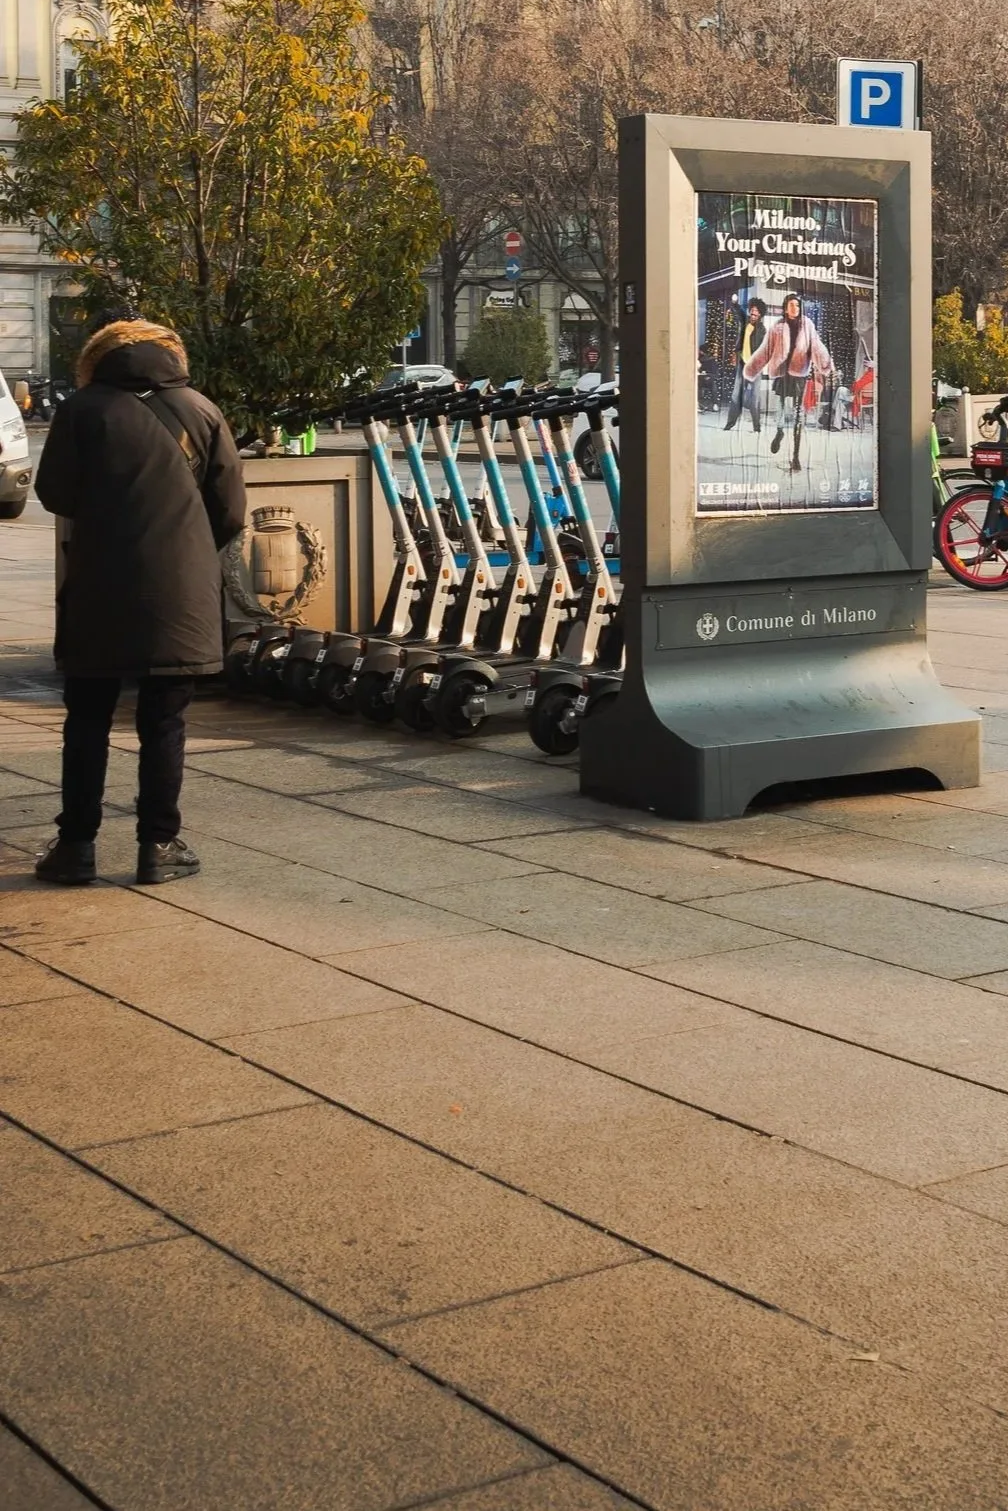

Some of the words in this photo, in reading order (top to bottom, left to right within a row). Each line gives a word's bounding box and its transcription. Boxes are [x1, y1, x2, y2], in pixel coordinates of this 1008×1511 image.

[860, 77, 891, 119] P
[750, 209, 821, 231] Milano.
[715, 232, 760, 252] Your
[762, 234, 857, 267] Christmas
[733, 257, 839, 284] Playground
[726, 615, 794, 632] Comune
[801, 609, 816, 626] di
[823, 607, 877, 624] Milano
